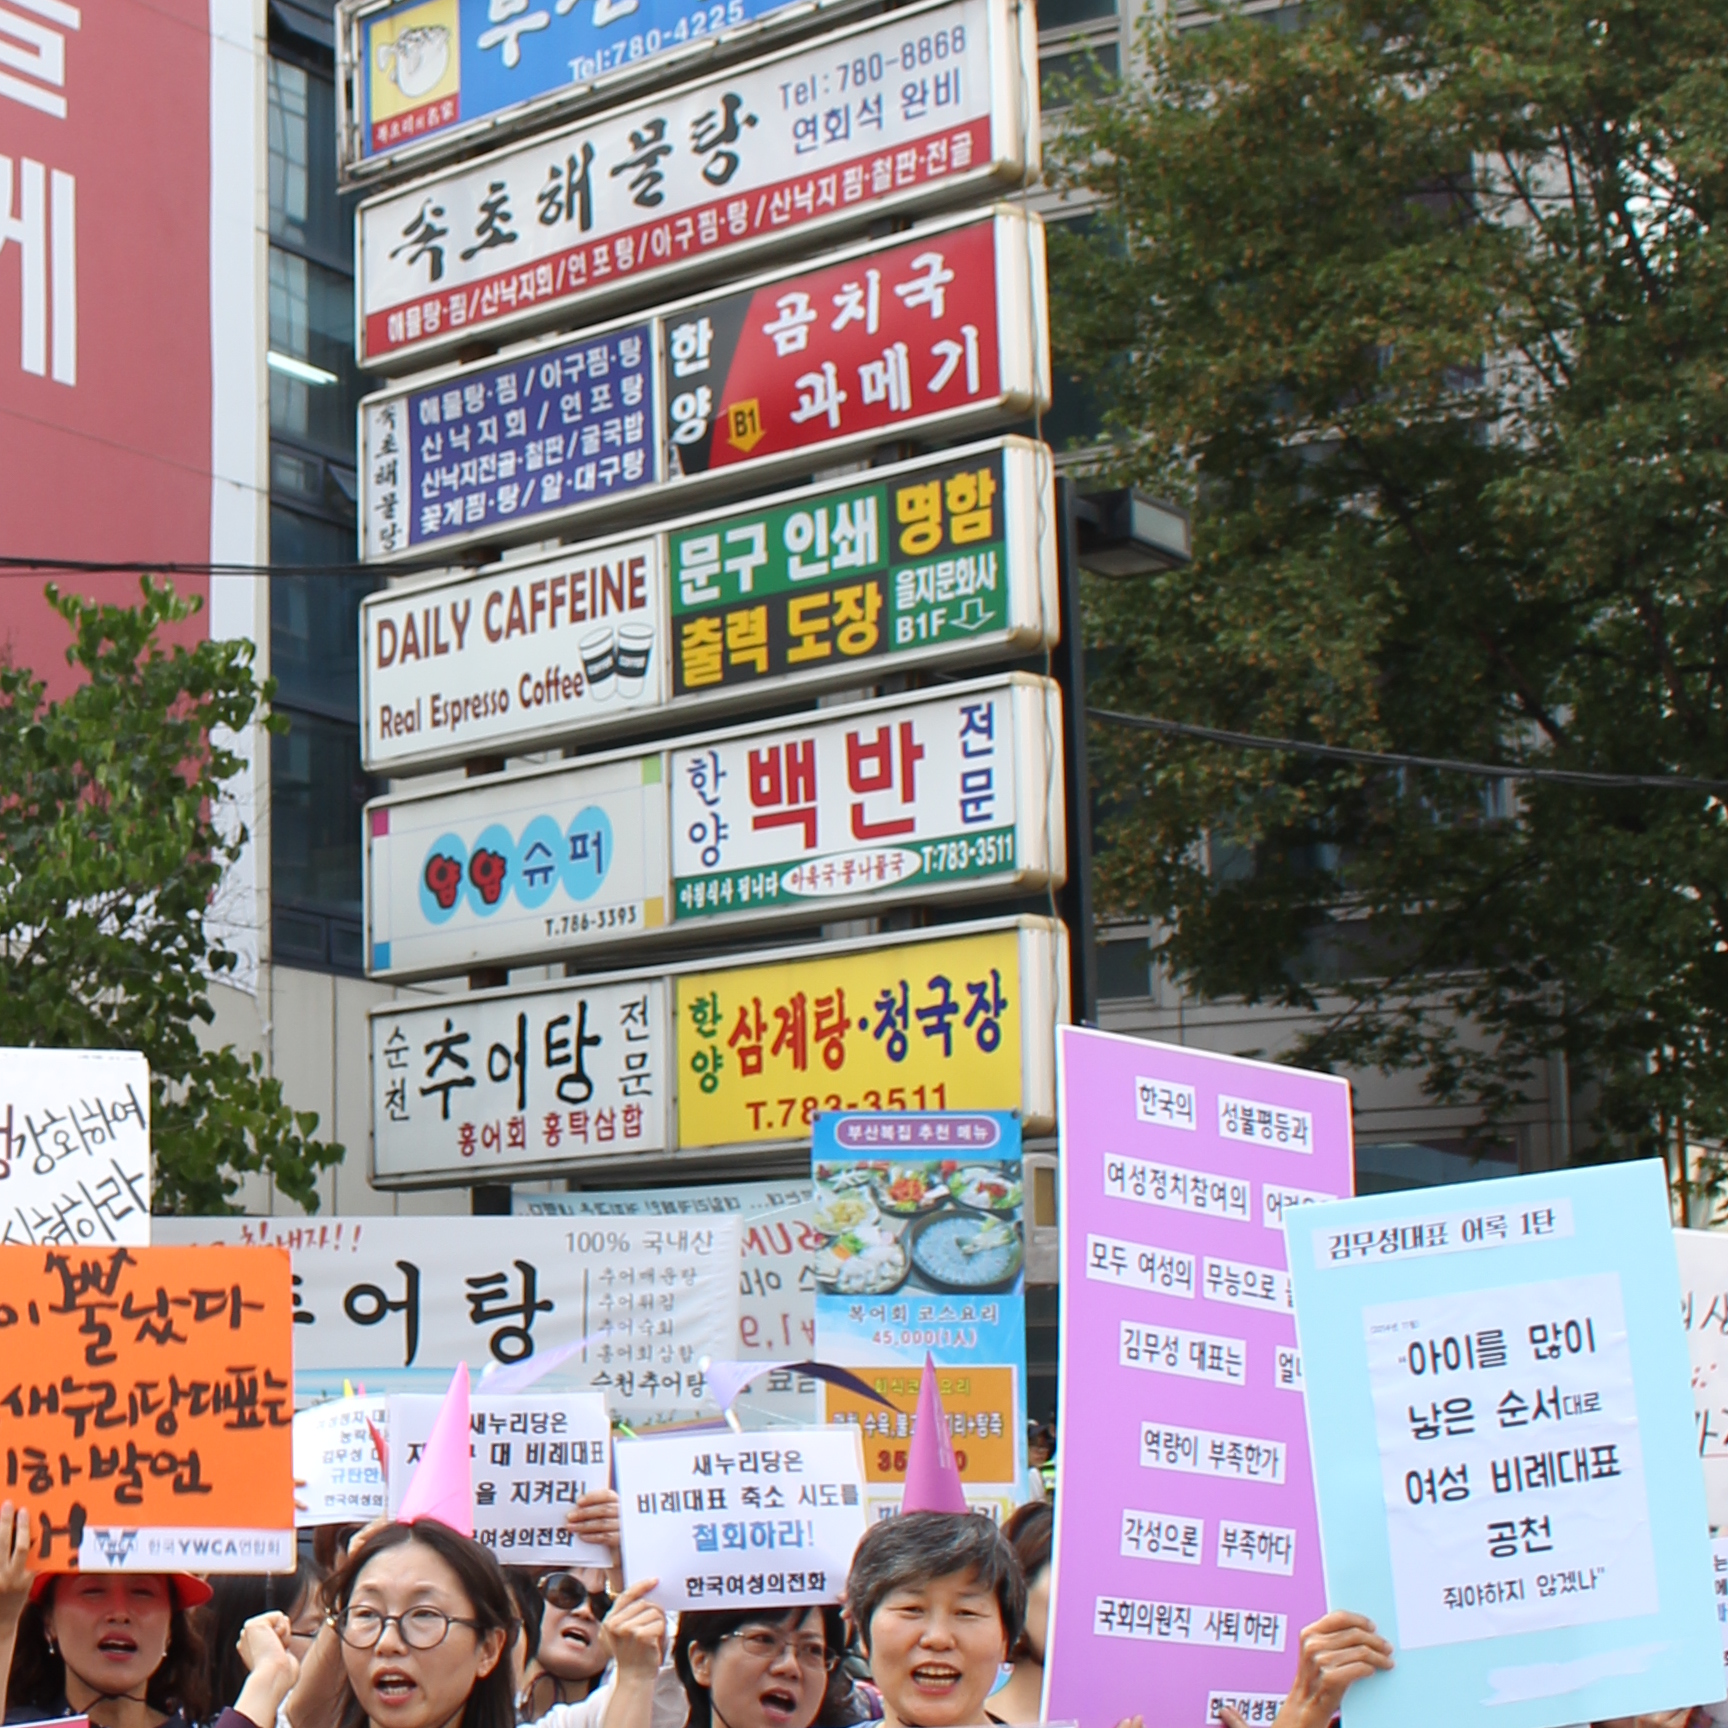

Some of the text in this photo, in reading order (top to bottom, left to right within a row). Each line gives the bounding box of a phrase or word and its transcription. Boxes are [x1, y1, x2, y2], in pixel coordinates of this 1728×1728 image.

[792, 68, 964, 155] 연회석 완비
[390, 92, 759, 283] 속초해물탕
[763, 252, 954, 357] 곰치국
[790, 325, 979, 429] 과메기
[734, 406, 758, 438] B1
[679, 468, 996, 605] 문구 인쇄 명함
[895, 551, 998, 610] 을지문화사
[376, 556, 646, 670] DAILY CAFFEINE
[681, 581, 883, 688] 출력 도장
[895, 608, 948, 644] B1F
[380, 665, 585, 740] Real Espresso Coffee
[747, 721, 925, 850] 백반
[960, 701, 995, 824] 전문
[419, 999, 602, 1121] 추어탕
[618, 994, 654, 1099] 전문
[688, 991, 724, 1095] 한양
[457, 1103, 644, 1159] 홍어회 홍탁삼합
[847, 1123, 990, 1143] 부산복집 추천 메뉴
[1138, 1083, 1309, 1149] 한국의 성불평등과
[1106, 1159, 1248, 1216] 여성정치참여의
[564, 1230, 631, 1254] 100%
[642, 1229, 714, 1256] 국내산
[1327, 1207, 1558, 1261] 김무성대표 어록 1탄
[1088, 1240, 1277, 1305] 모두 여성의 무능으로
[917, 1303, 1001, 1325] 코스요리
[1528, 1316, 1597, 1362] 많이
[1122, 1328, 1181, 1369] 김무성
[1187, 1338, 1243, 1380] 대표는
[1407, 1384, 1603, 1442] 낳은 순서대로
[490, 1441, 606, 1466] 대 비례대표
[692, 1450, 804, 1477] 새누리당은
[1143, 1427, 1280, 1480] 역량이 부족한가
[1404, 1443, 1623, 1507] 여성 비례대표
[636, 1483, 860, 1515] 비례대표 축소 시도를
[692, 1519, 816, 1553] 철회하라!
[1123, 1516, 1292, 1568] 각성으론 부족하다
[1485, 1513, 1555, 1559] 공천
[685, 1571, 828, 1599] 한국여성의전화
[1441, 1576, 1527, 1612] 줘야하지
[1097, 1597, 1193, 1640] 국회의원직
